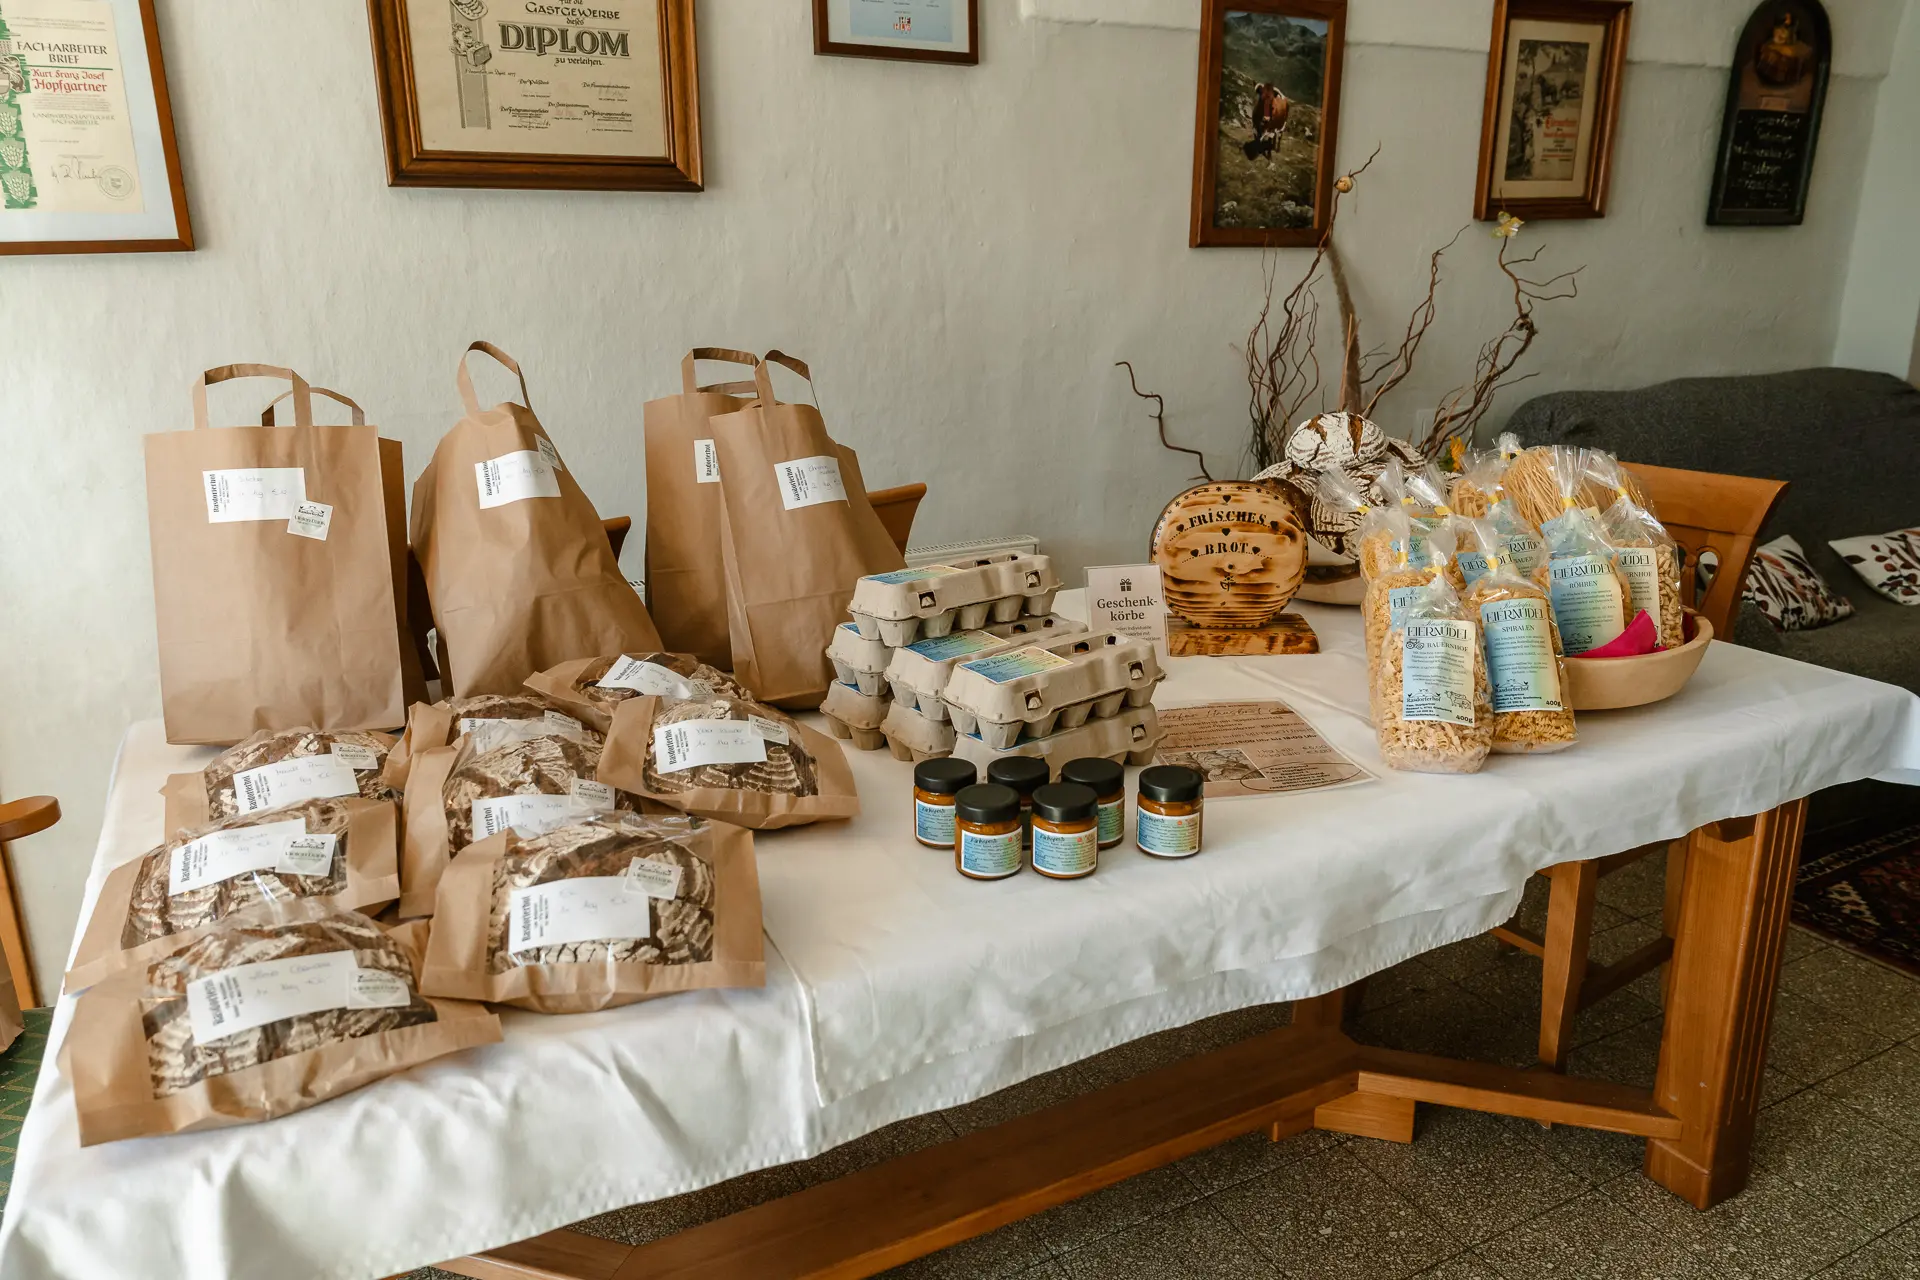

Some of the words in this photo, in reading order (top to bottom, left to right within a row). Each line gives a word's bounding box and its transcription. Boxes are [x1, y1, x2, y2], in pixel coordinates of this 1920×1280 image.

[525, 1, 620, 19] GASTGEWERBE
[498, 22, 630, 56] DIPLOM
[17, 41, 108, 55] FACHARBEITER
[49, 54, 80, 64] BRIEF
[554, 57, 566, 68] zu
[31, 68, 52, 77] Kurt
[32, 78, 108, 94] Hopfgartner
[1204, 541, 1250, 556] BROT
[1569, 580, 1598, 589] RÖHREN
[1096, 596, 1158, 609] Geschenk-
[1110, 609, 1145, 622] körbe
[1486, 607, 1547, 623] EIERNUDEL
[1407, 626, 1471, 640] EIERNUDEL
[1501, 624, 1535, 632] SPIRALEN
[1427, 642, 1468, 651] BAUERNHOF
[1455, 714, 1473, 724] 400g
